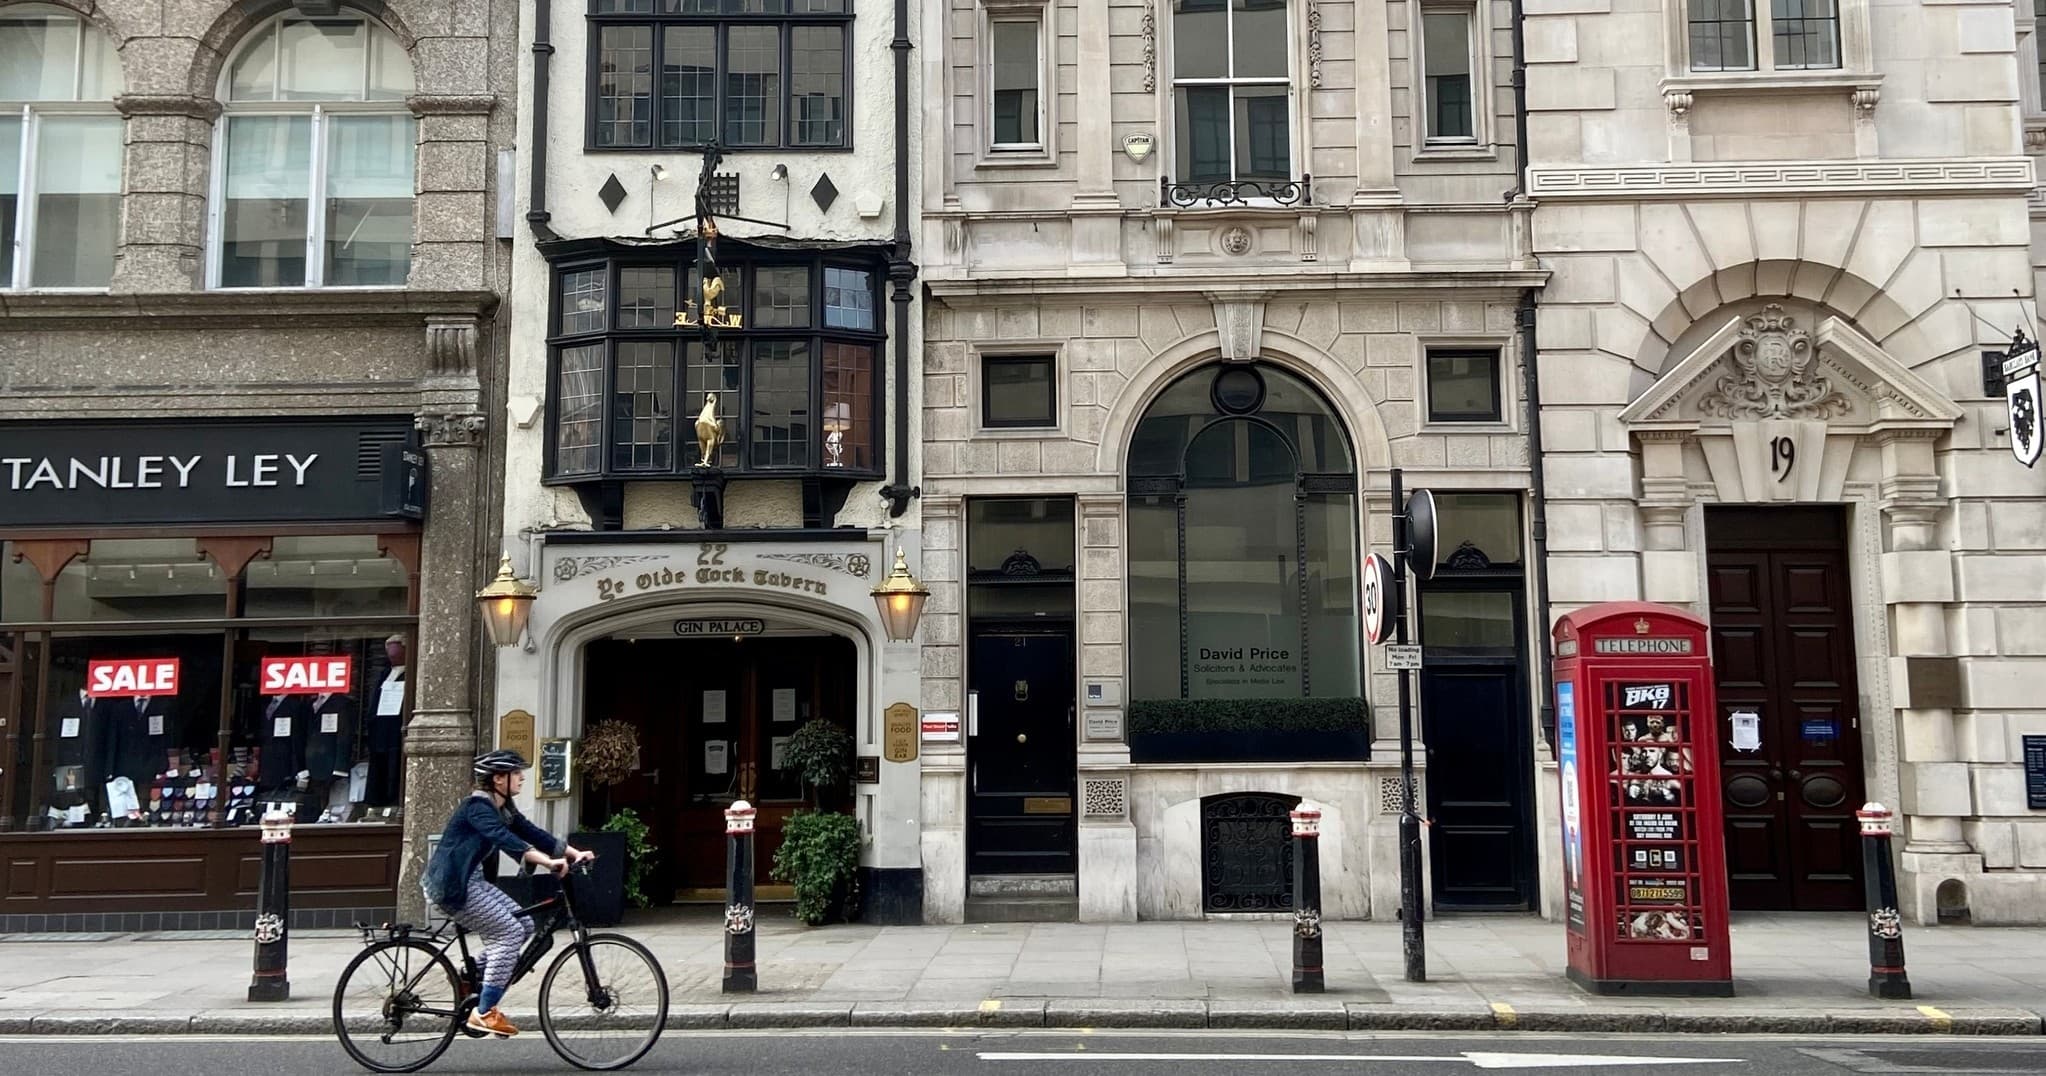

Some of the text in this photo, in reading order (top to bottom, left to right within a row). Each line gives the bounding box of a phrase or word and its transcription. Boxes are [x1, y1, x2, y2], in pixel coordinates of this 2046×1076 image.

[1770, 436, 1795, 483] 19
[2, 454, 318, 490] TANLEY LEY
[696, 543, 728, 565] 22
[597, 567, 827, 601] Ye Olde Cock Tavern
[1366, 581, 1377, 616] 30
[678, 621, 759, 633] GIN PALACE
[1200, 648, 1289, 660] David Price
[1398, 646, 1420, 654] loading
[1600, 639, 1689, 652] TELEPHONE
[92, 664, 175, 691] SALE
[265, 662, 347, 689] SALE
[1193, 664, 1297, 673] Solicitors & Advocates
[1652, 700, 1668, 709] 17
